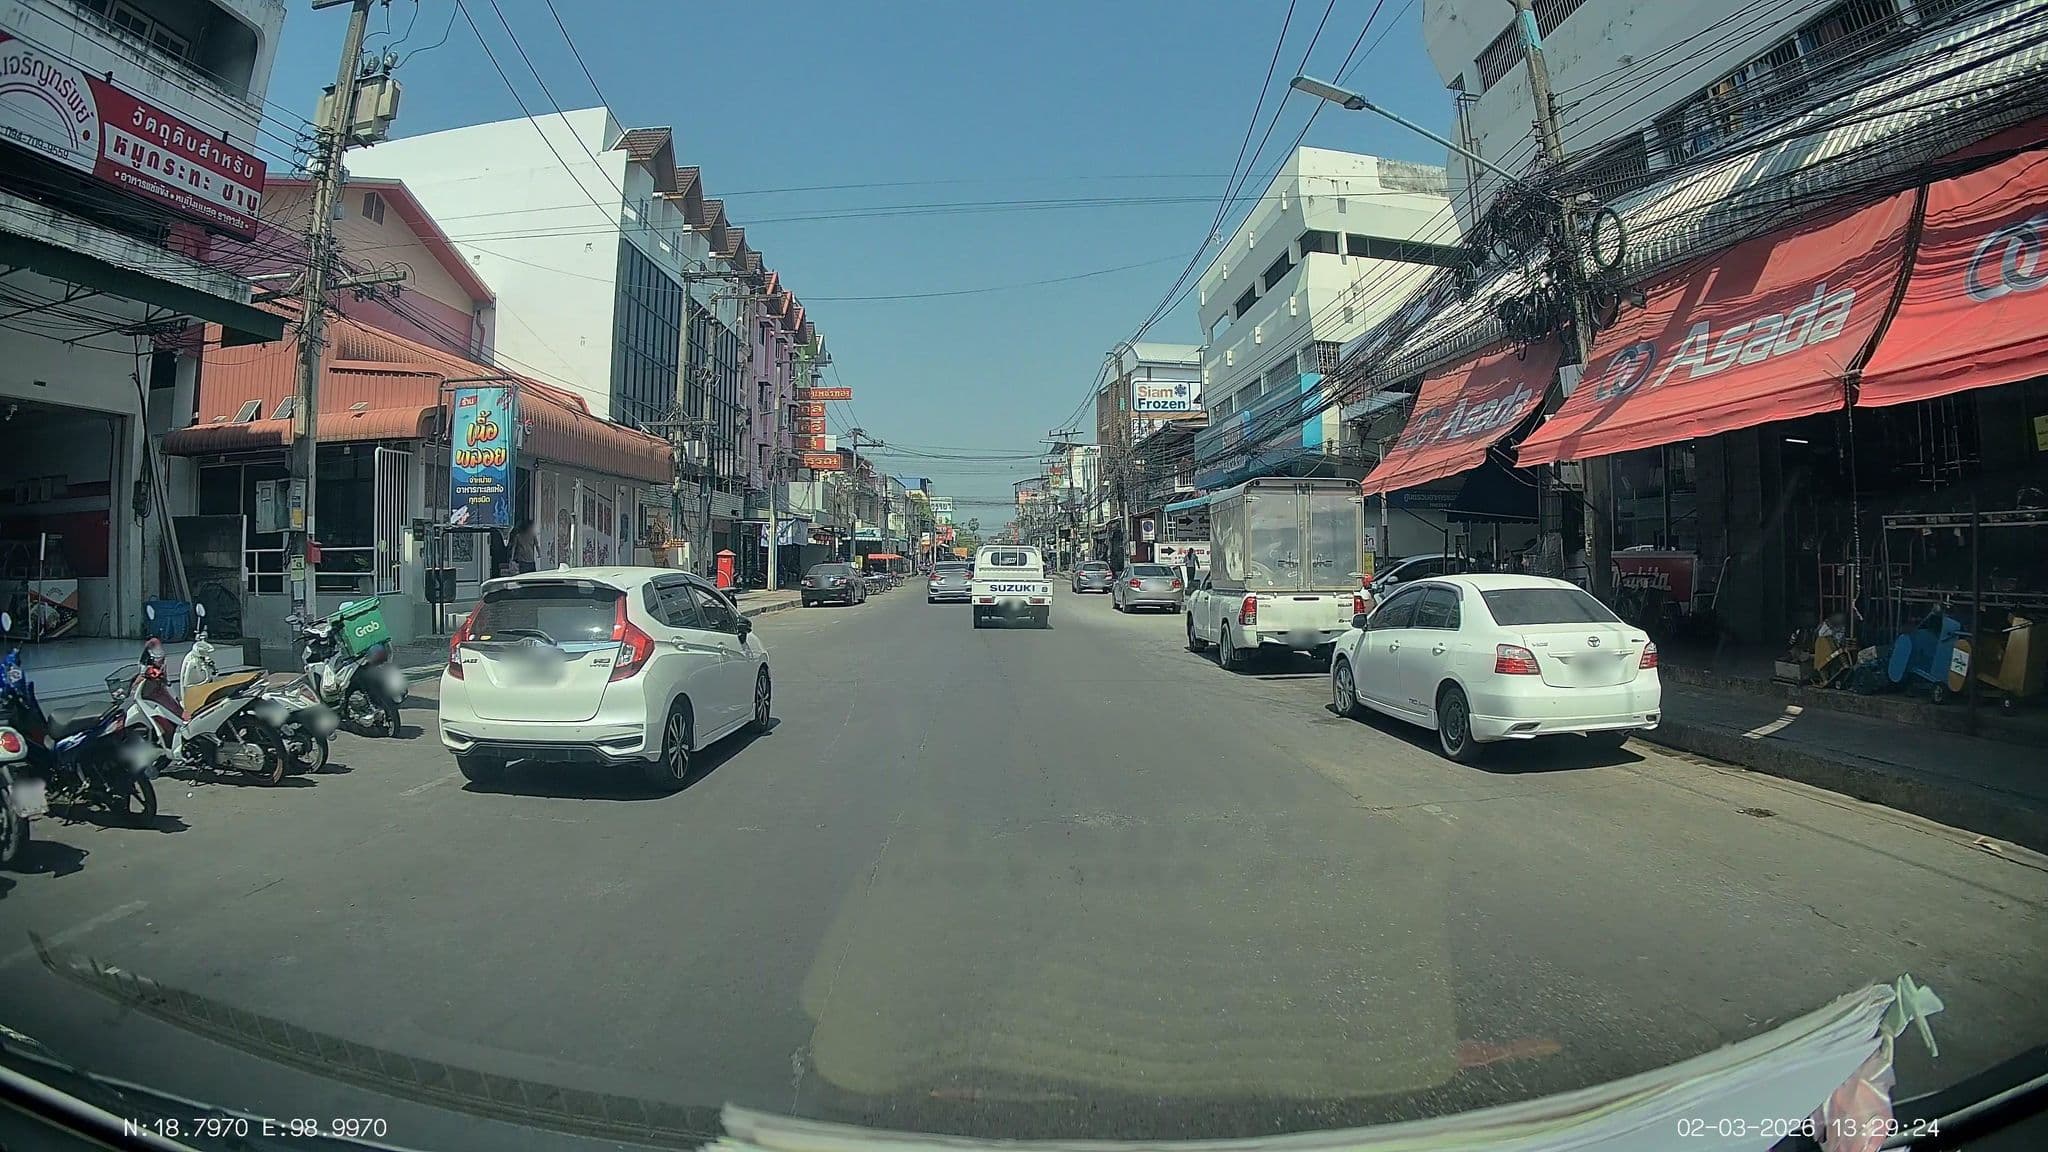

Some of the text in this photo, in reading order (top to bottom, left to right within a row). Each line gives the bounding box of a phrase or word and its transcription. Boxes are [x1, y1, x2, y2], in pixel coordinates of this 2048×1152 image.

[132, 105, 254, 179] วัตถุดิบสำหรับ
[113, 135, 259, 218] หมูกระทะ ชาบู
[1651, 281, 1856, 388] Asada
[1137, 384, 1174, 398] Siam
[1137, 398, 1186, 409] Frozen
[455, 447, 507, 469] พลอย
[990, 584, 1036, 592] SUZUKI
[355, 620, 380, 638] Grab
